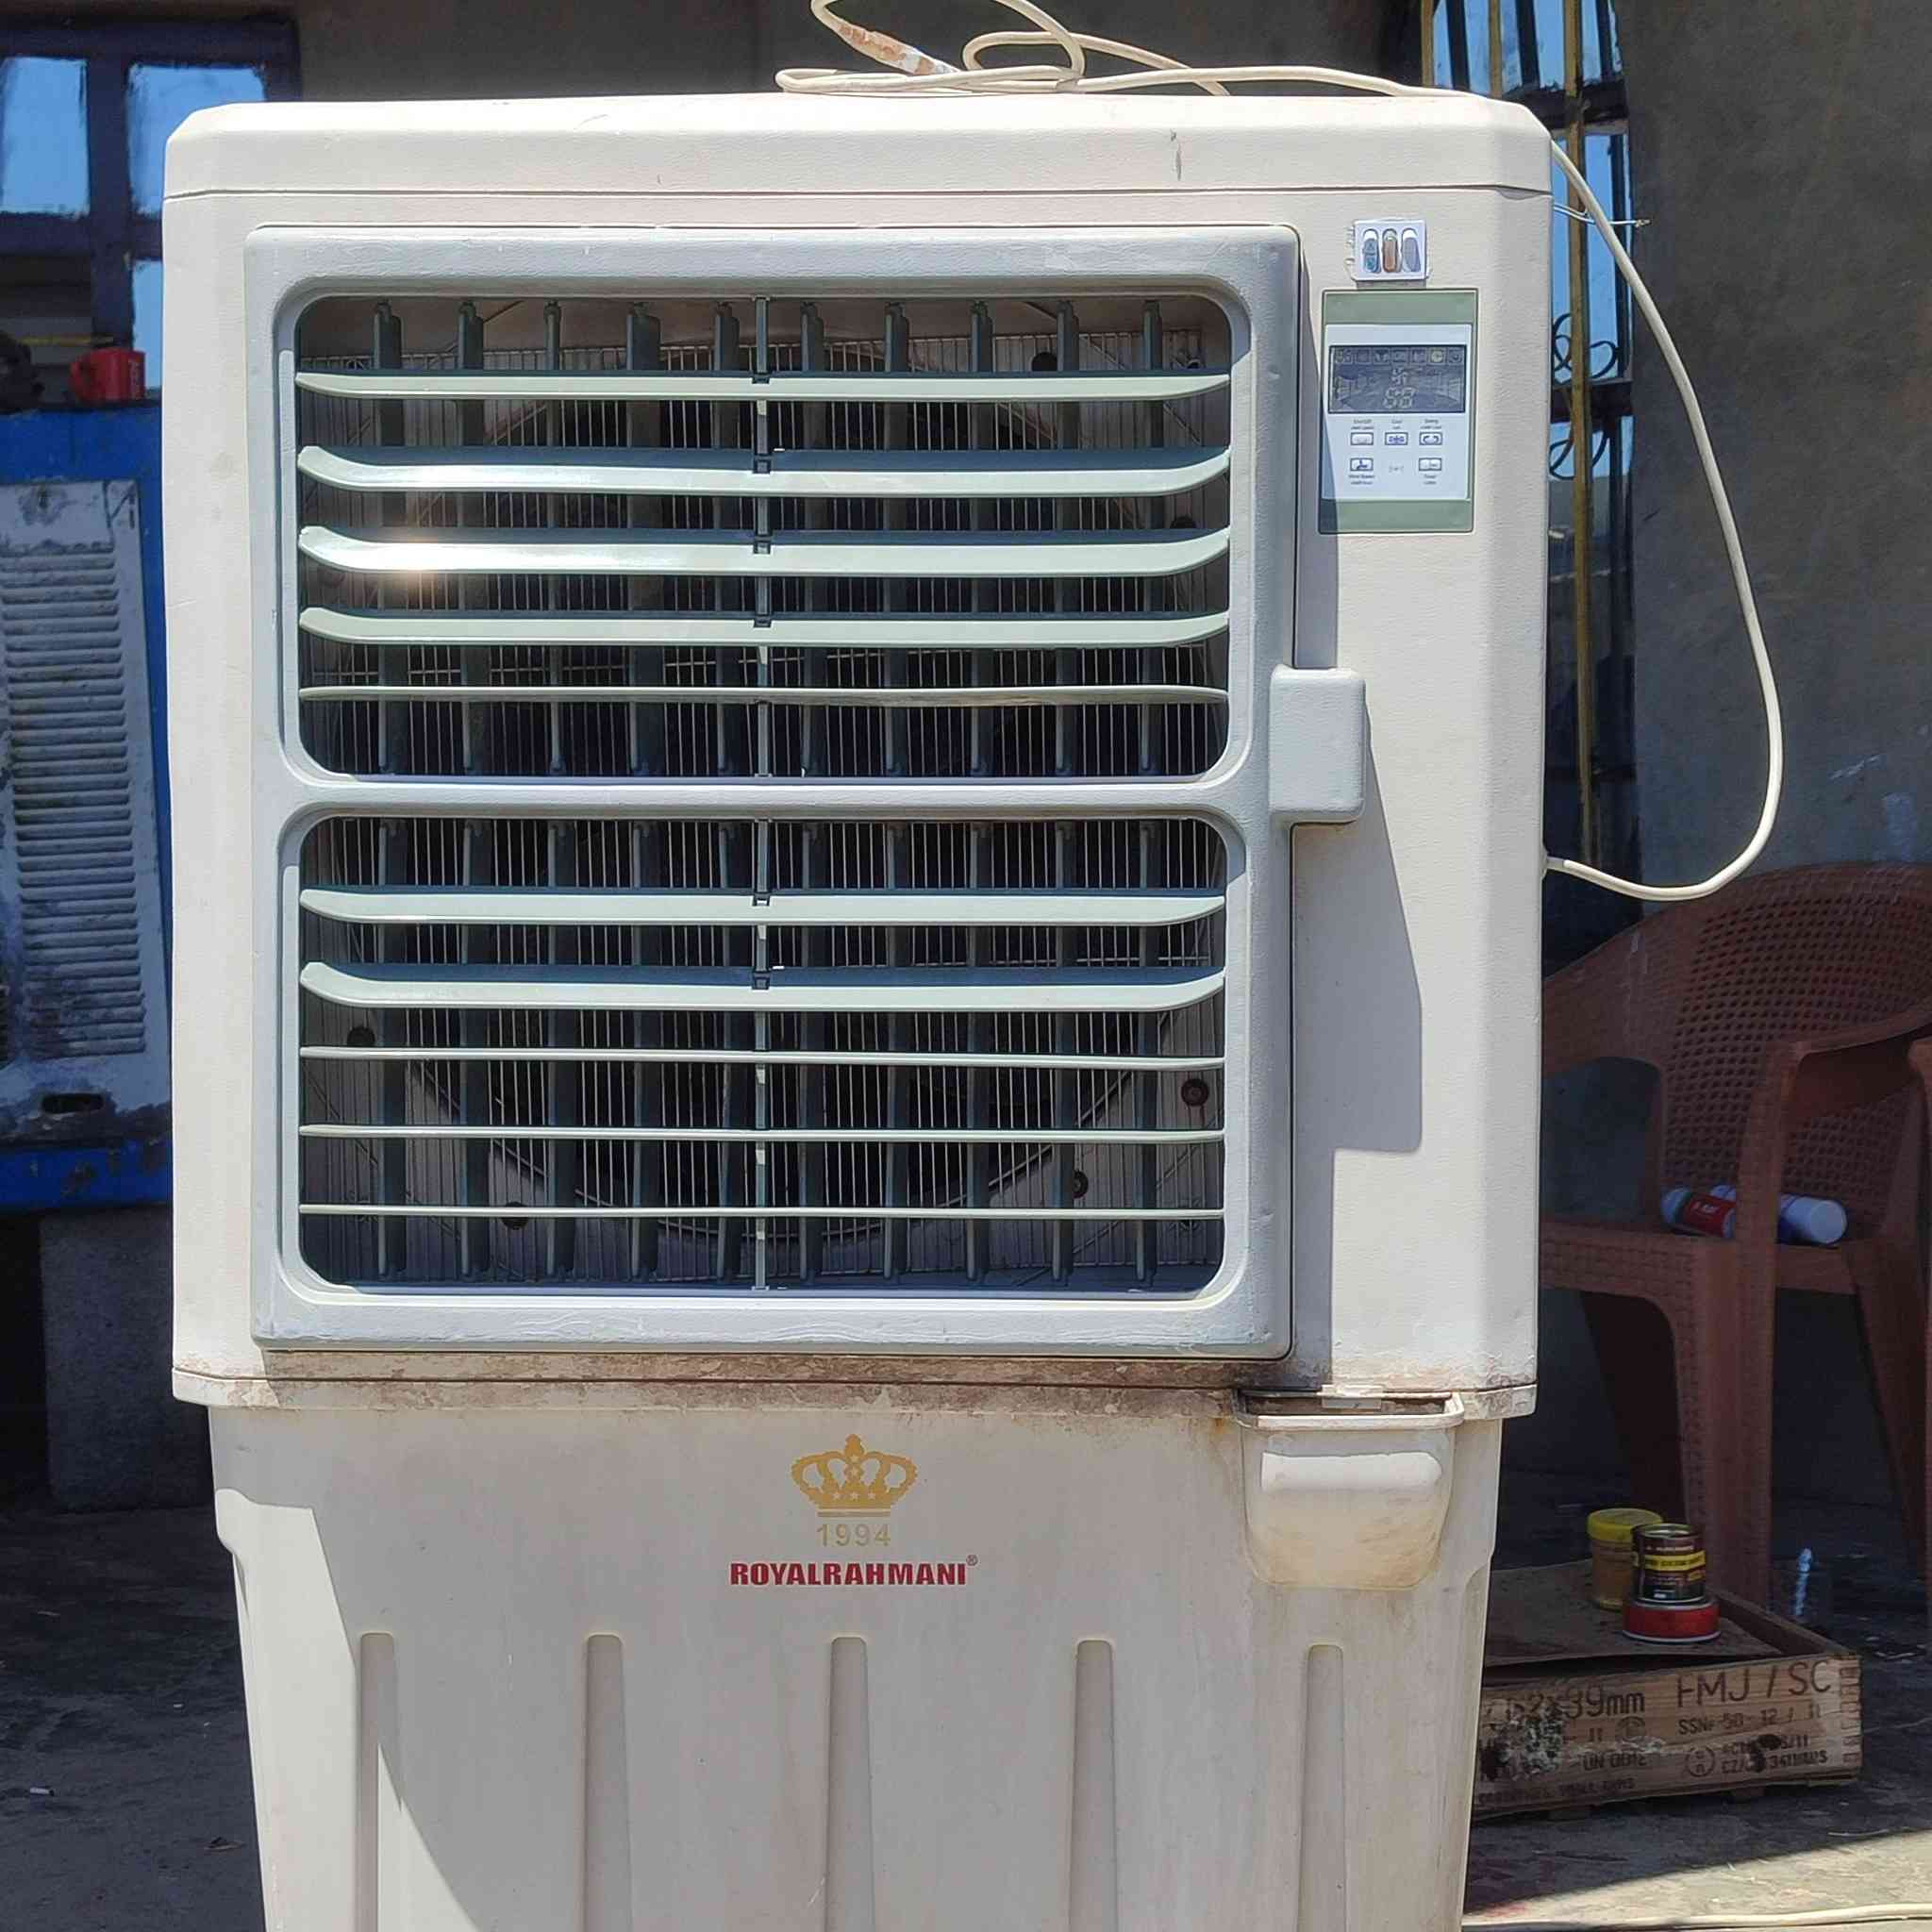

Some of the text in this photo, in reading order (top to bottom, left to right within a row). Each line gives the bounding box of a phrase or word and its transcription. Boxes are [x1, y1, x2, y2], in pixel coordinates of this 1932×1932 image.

[816, 1524, 891, 1547] 1994
[729, 1562, 967, 1586] ROYALRAHMANI
[1788, 1659, 1831, 1696] SC
